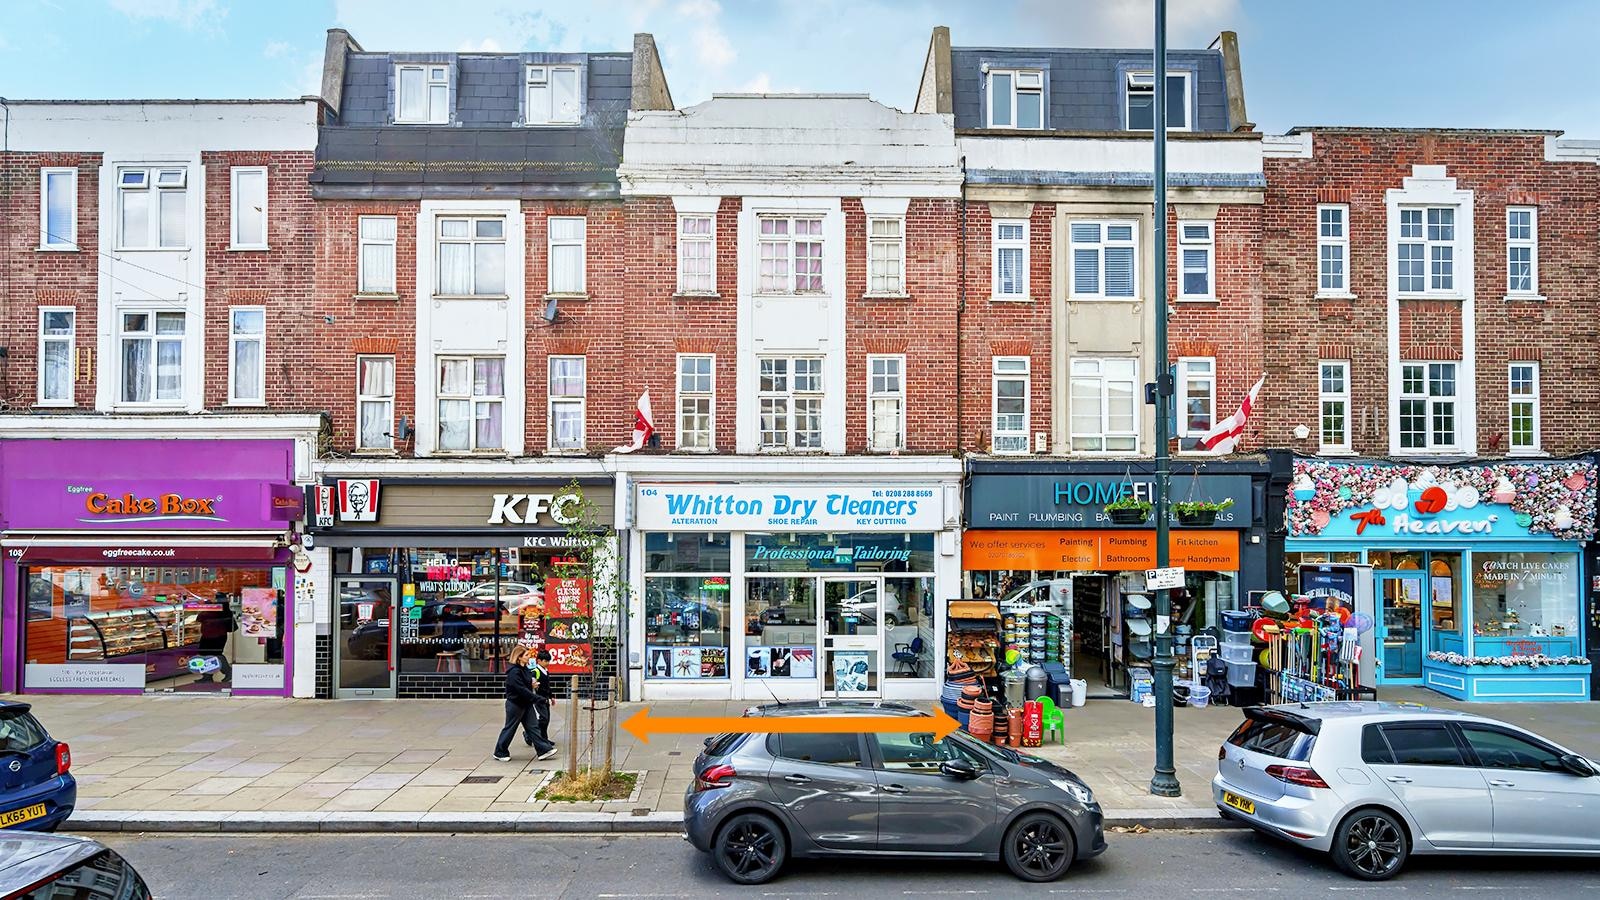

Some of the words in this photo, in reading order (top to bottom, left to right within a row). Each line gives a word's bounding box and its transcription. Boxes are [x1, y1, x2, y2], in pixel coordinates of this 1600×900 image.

[67, 485, 93, 493] Eggfree
[86, 493, 157, 515] Cake
[160, 494, 216, 515] Box
[488, 494, 581, 524] KFC
[665, 494, 763, 515] Whitton
[773, 494, 818, 520] Dry
[826, 494, 918, 516] Cleaners
[318, 517, 332, 526] KFC
[989, 512, 1019, 521] PAINT
[1028, 512, 1083, 521] PLUMBING
[1350, 508, 1386, 535] 7th
[1393, 512, 1492, 534] Heaven
[523, 536, 547, 547] KFC
[970, 541, 985, 549] We
[987, 540, 1009, 549] offer
[1010, 541, 1046, 549] services
[1060, 538, 1093, 547] Painting
[1109, 538, 1148, 547] Plumbing
[1176, 538, 1187, 546] Fit
[1189, 538, 1219, 546] kitchen
[8, 548, 24, 557] 108
[102, 548, 176, 558] eggfreecake.co.uk
[752, 545, 840, 560] Professional
[853, 545, 912, 562] Tailoring
[427, 558, 458, 567] HELLO
[1062, 555, 1091, 563] Electric
[1106, 554, 1151, 563] Bathrooms
[1187, 554, 1231, 564] Handyman
[1482, 561, 1519, 573] WATCH
[1521, 562, 1540, 570] LIVE
[1541, 562, 1570, 570] CAKES
[1483, 572, 1509, 580] MADE
[1522, 570, 1530, 581] 7
[1531, 572, 1568, 580] MINUTES
[420, 581, 443, 592] WHAT'S
[548, 648, 565, 665] £5
[0, 810, 26, 826] LK65
[27, 804, 44, 817] YUT
